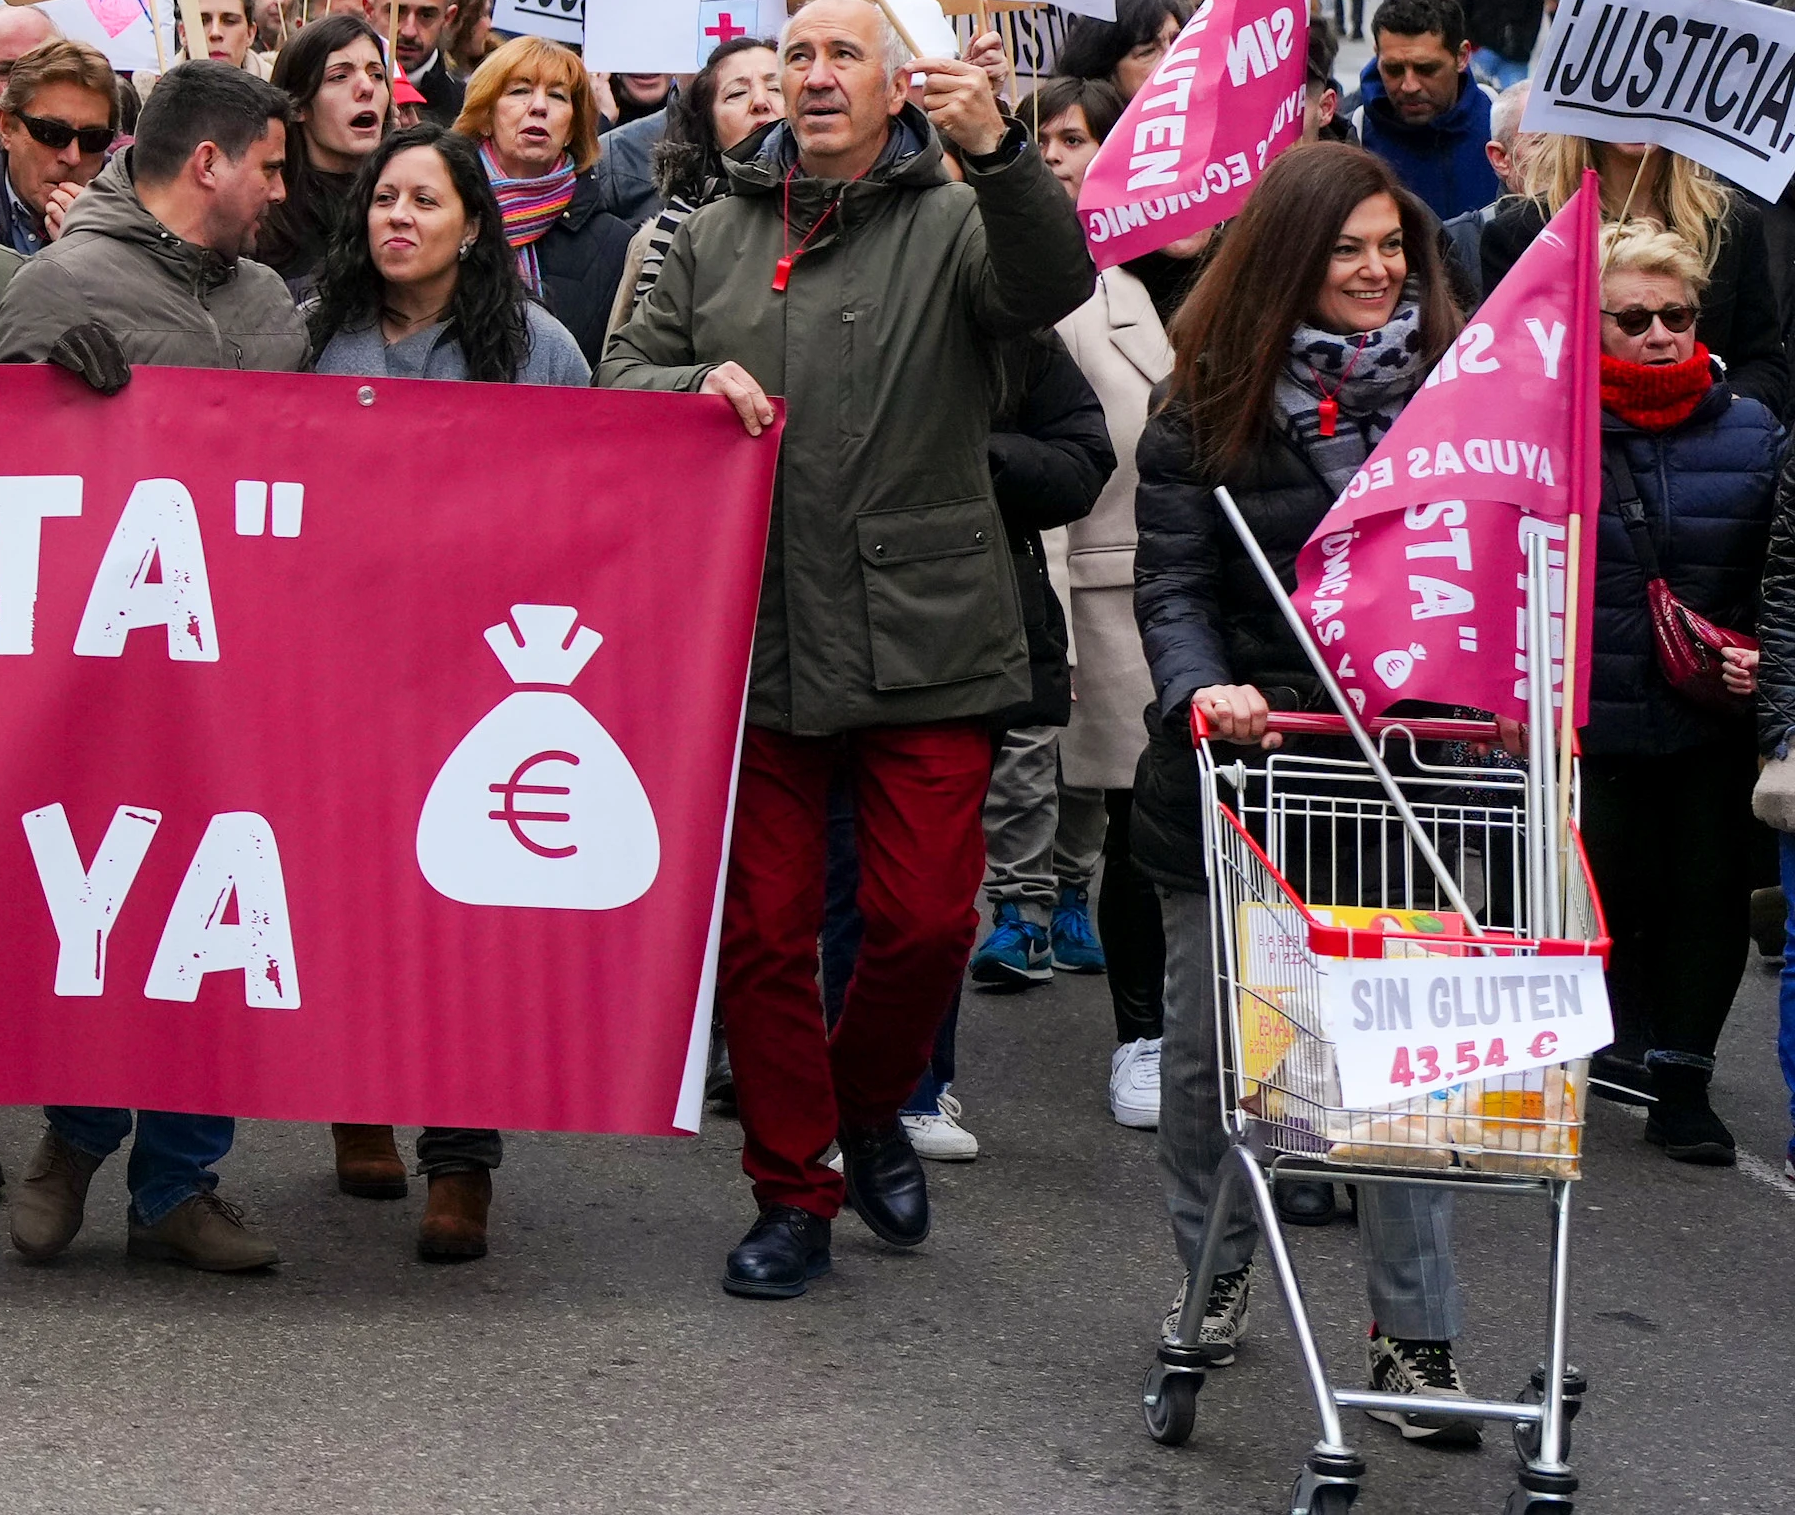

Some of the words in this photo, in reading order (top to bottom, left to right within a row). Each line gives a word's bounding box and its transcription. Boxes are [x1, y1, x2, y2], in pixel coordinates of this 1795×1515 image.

[22, 803, 301, 1009] YA
[1350, 975, 1413, 1032] SIN
[1427, 974, 1583, 1030] GLUTEN
[1389, 1036, 1509, 1088] 43,54
